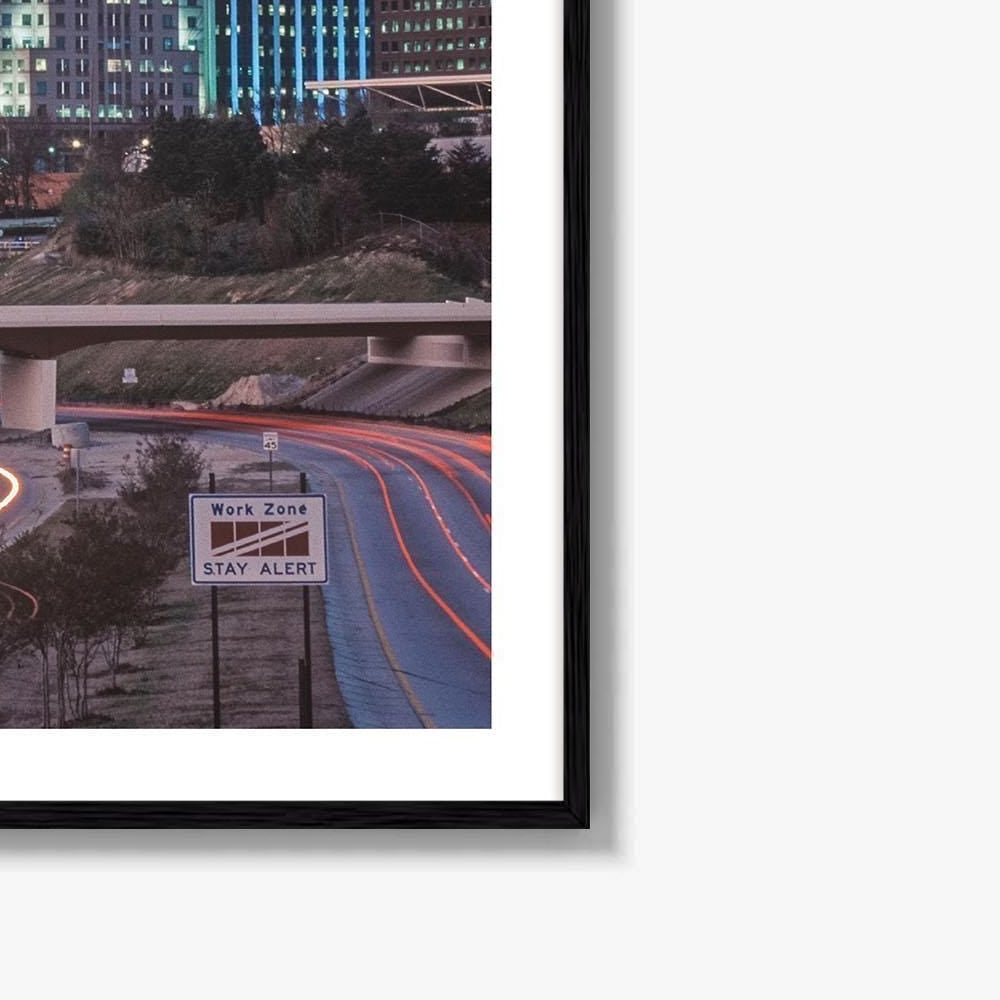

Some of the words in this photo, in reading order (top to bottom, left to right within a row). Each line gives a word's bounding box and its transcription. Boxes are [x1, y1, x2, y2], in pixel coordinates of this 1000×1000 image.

[264, 441, 277, 449] 45
[211, 503, 254, 516] Work
[263, 503, 308, 516] Zone
[203, 562, 248, 575] STAY
[259, 562, 317, 575] ALERT
